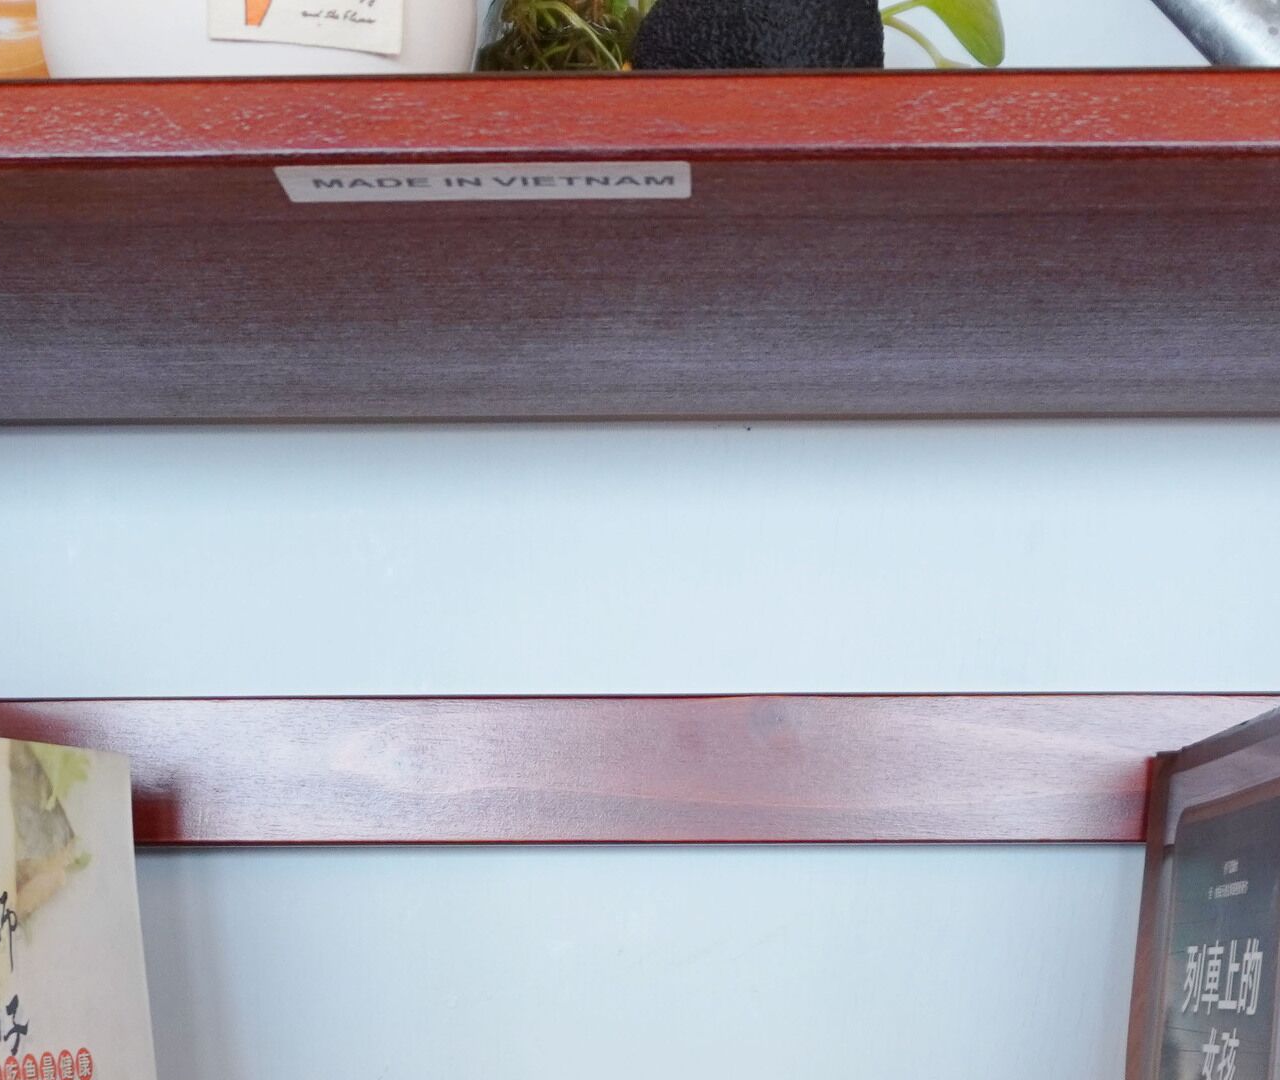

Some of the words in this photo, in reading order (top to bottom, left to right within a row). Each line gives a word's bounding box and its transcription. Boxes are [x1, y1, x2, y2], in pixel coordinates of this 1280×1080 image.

[312, 176, 429, 189] MADE
[444, 176, 482, 188] IN
[492, 174, 675, 188] VIETNAM
[1181, 937, 1264, 1017] 列車上的
